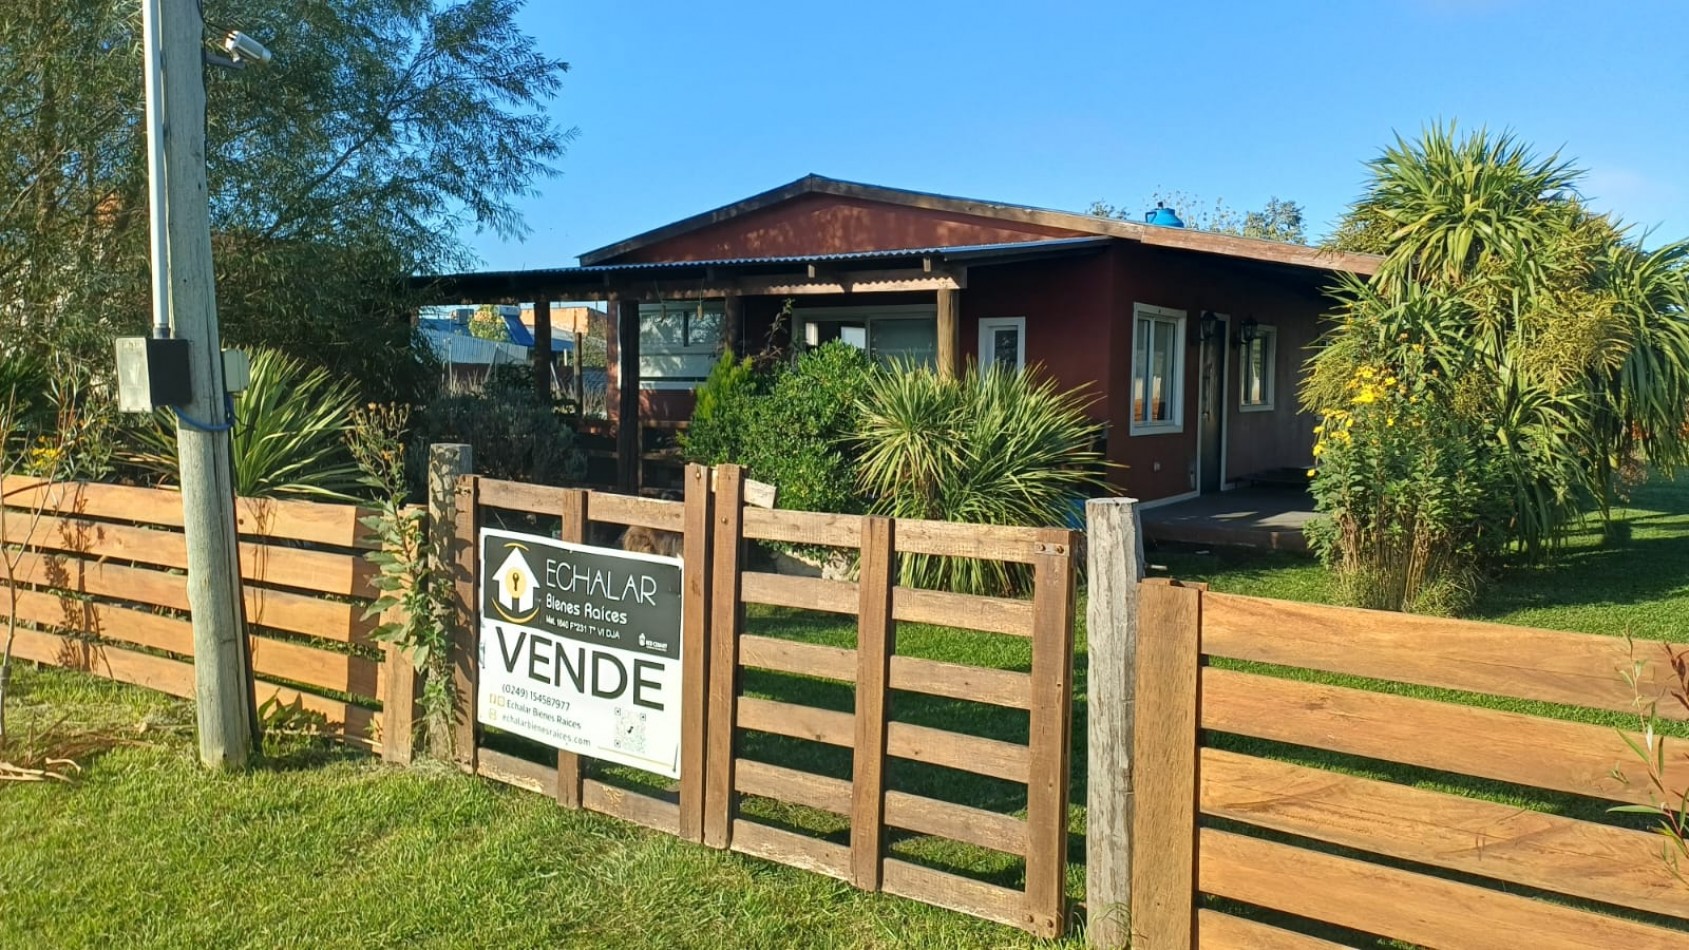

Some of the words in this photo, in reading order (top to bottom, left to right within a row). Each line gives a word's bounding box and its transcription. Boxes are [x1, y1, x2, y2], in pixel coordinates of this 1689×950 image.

[546, 558, 657, 606] ECHALAR
[546, 593, 581, 616] Bienes
[584, 602, 628, 625] Raíces
[496, 626, 665, 711] VENDE
[502, 683, 529, 699] (0249)
[530, 691, 571, 711] 154587977
[506, 699, 531, 714] Echalar
[533, 707, 555, 722] Bienes
[502, 714, 591, 746] echalarbienesraices.com
